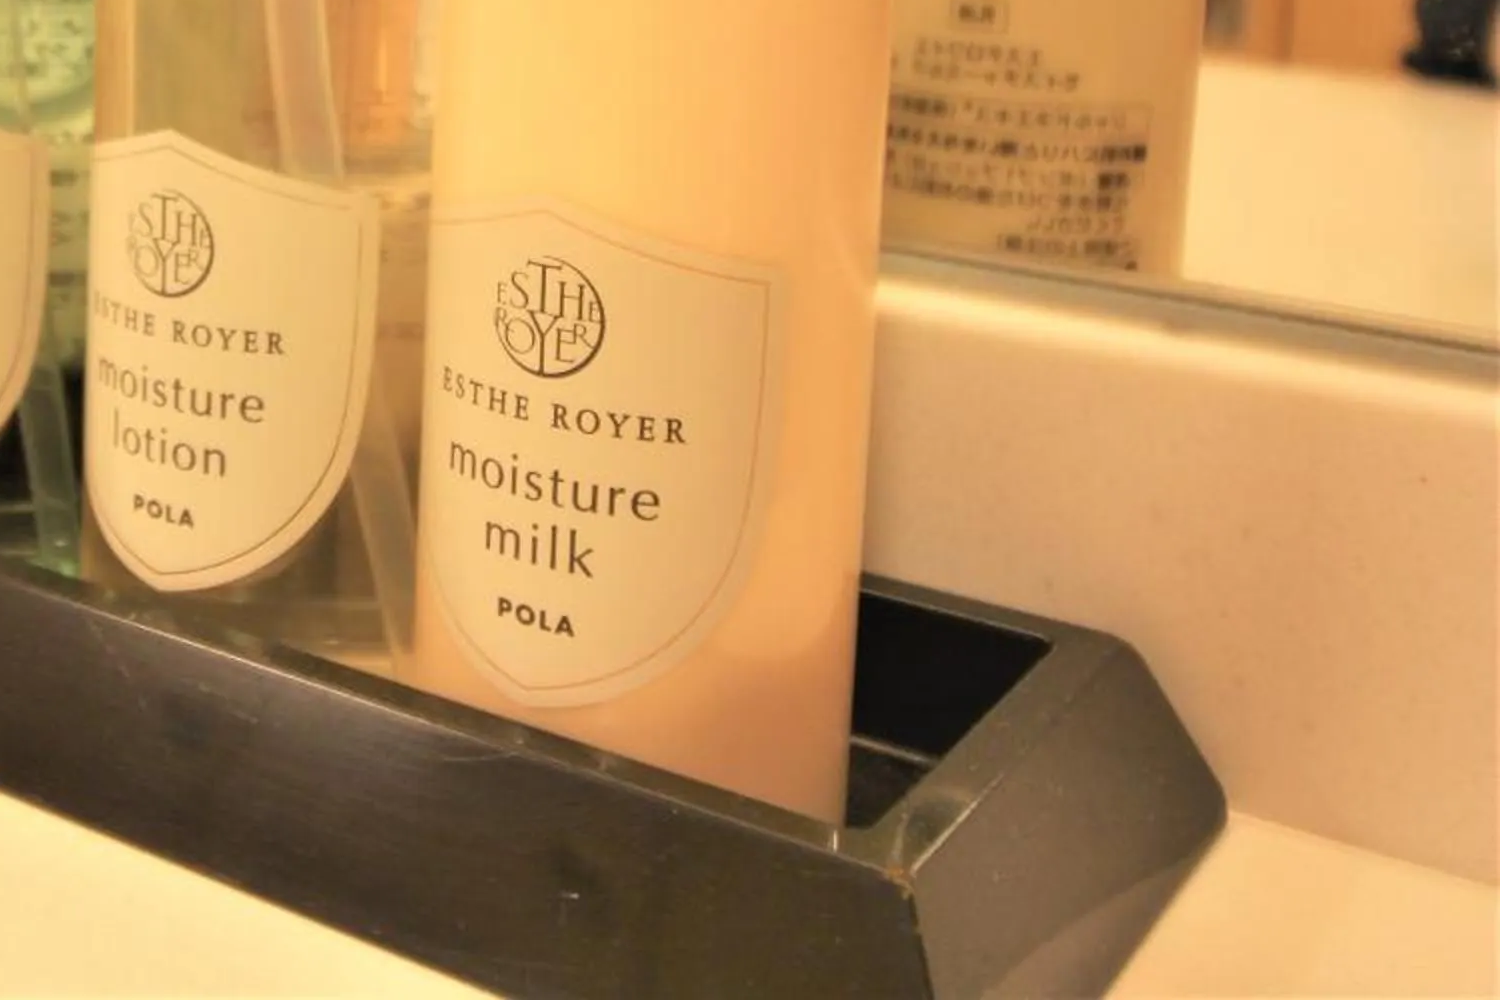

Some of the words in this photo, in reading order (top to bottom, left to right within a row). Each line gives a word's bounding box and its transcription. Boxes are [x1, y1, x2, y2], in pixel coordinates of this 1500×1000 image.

[172, 319, 286, 356] ROYER
[99, 356, 265, 424] moisture
[442, 366, 529, 421] ESTHE
[550, 403, 687, 444] ROYER
[113, 408, 226, 477] lotion
[133, 494, 195, 530] POLA
[449, 440, 661, 521] moisture
[485, 520, 594, 579] milk
[497, 597, 575, 638] POLA
